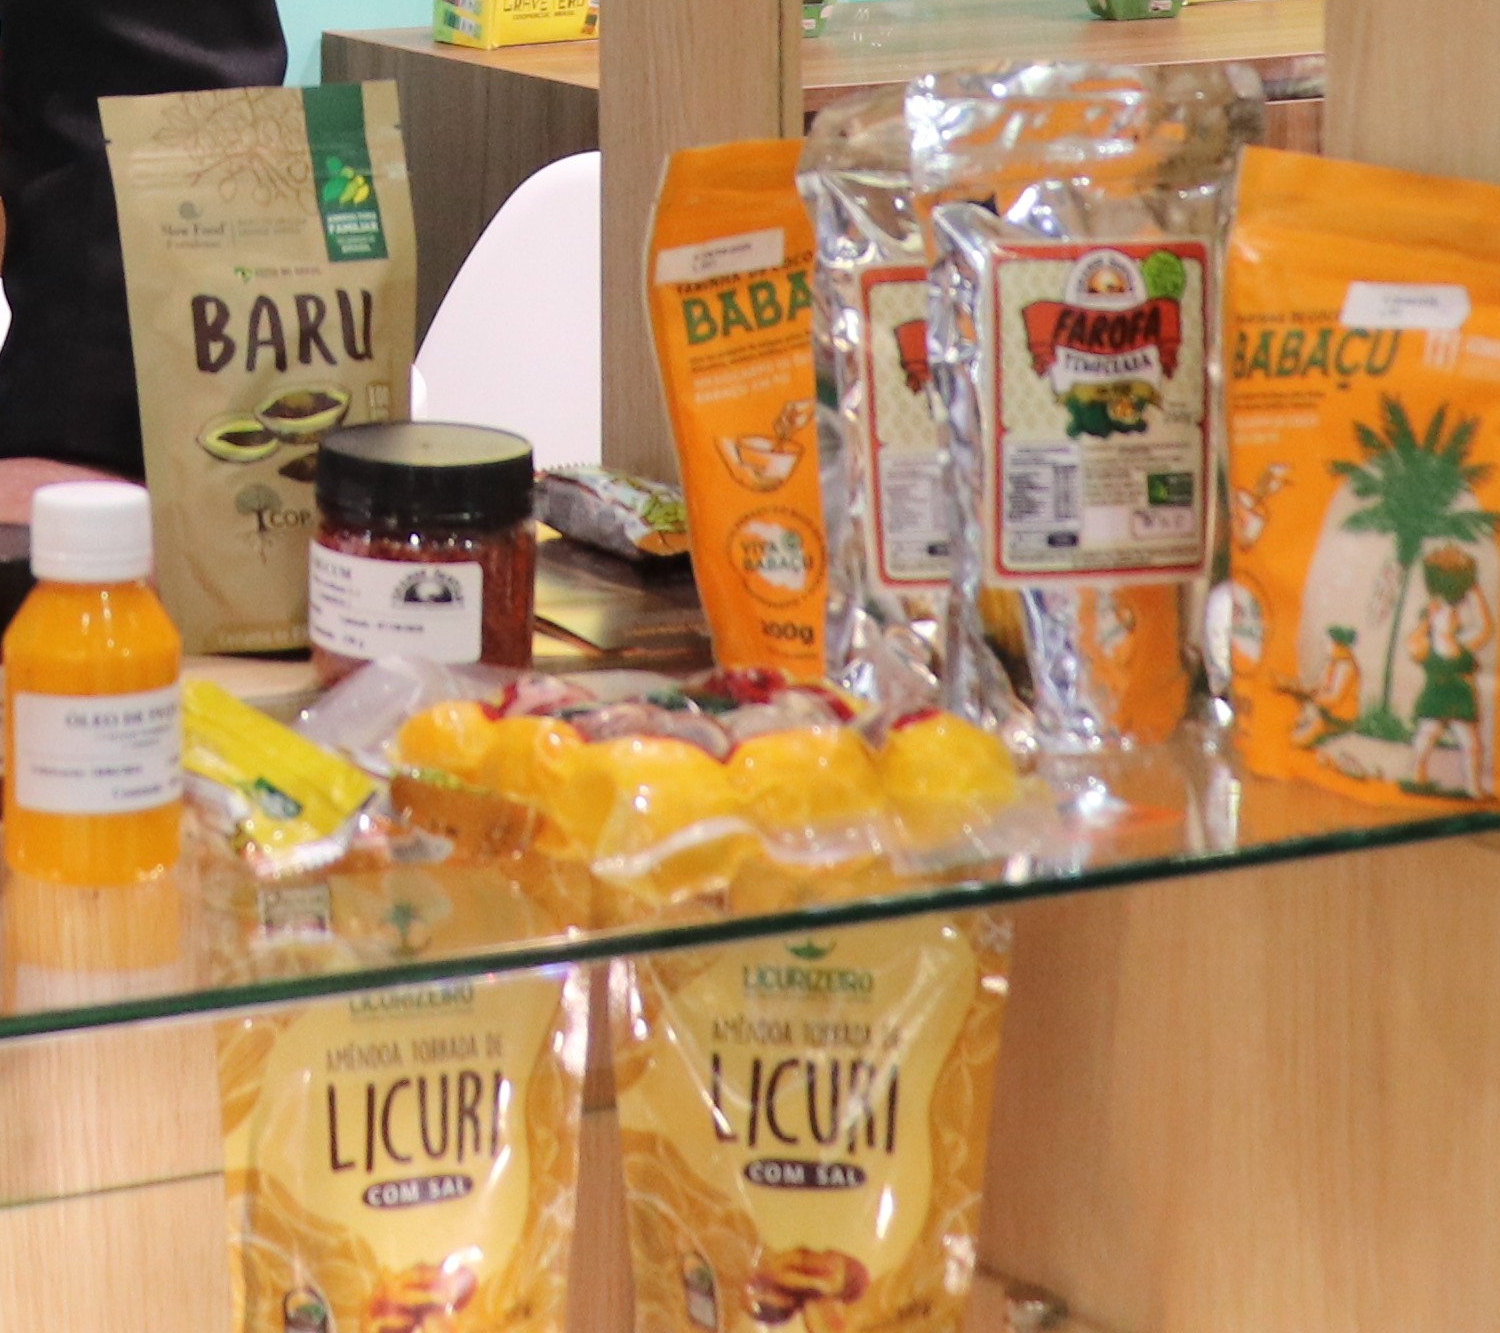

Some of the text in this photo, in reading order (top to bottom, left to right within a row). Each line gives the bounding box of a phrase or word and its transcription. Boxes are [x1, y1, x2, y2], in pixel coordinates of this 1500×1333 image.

[191, 288, 374, 374] BARU
[681, 269, 813, 346] BABA
[1053, 308, 1162, 349] FAROFA
[1232, 327, 1404, 391] BABAÇU
[269, 509, 312, 528] COP
[743, 964, 874, 994] LICURIZEIRO
[328, 1070, 504, 1174] LICURI
[712, 1052, 899, 1156] LICURI
[367, 1177, 467, 1207] COM SAL
[748, 1162, 859, 1186] COM SAL
